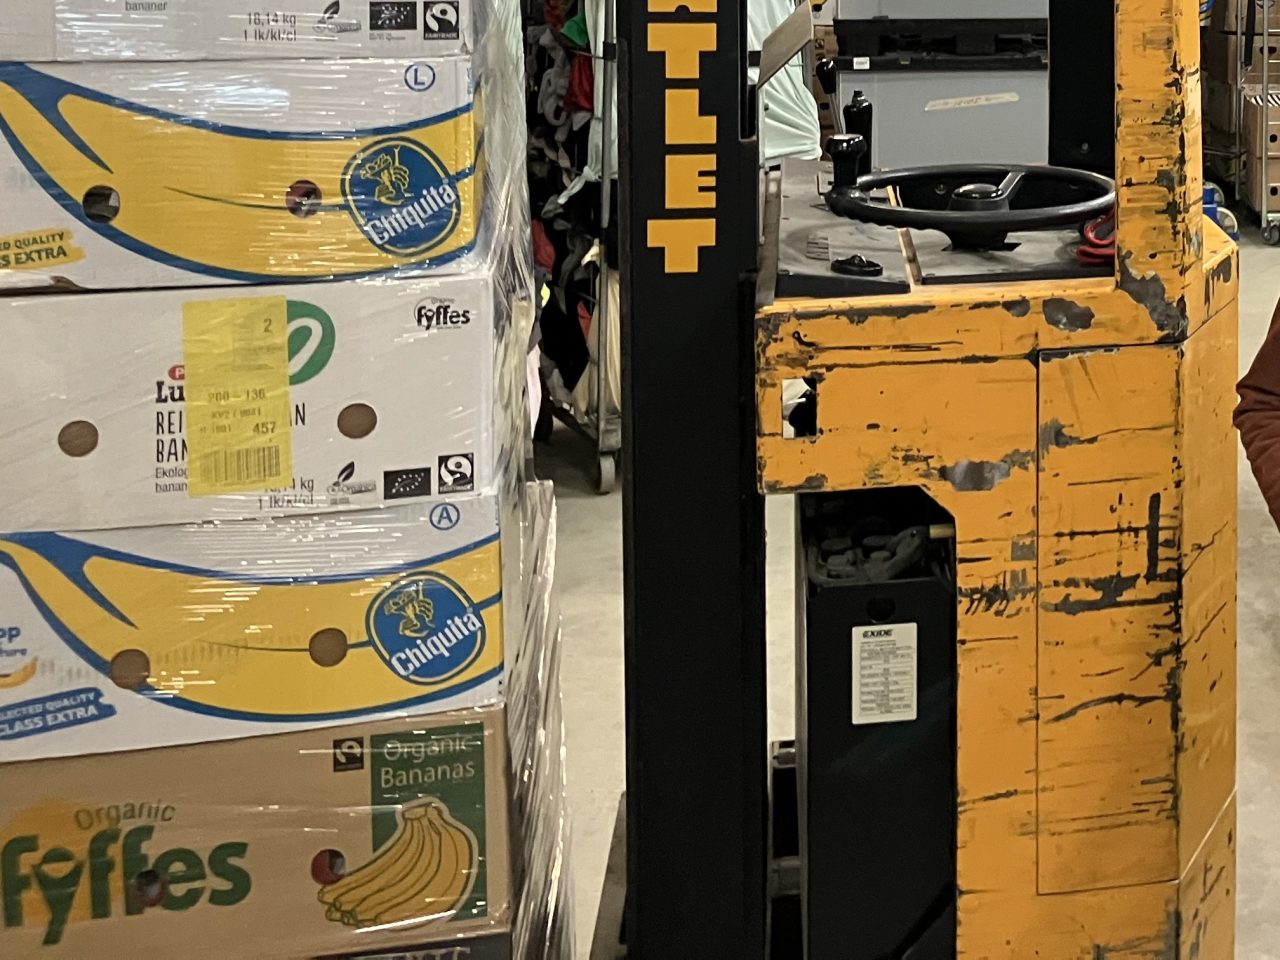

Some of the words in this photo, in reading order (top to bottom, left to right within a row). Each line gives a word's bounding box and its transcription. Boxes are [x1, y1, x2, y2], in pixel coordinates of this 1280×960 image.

[124, 0, 168, 12] bananer
[247, 11, 279, 27] 18,14
[282, 12, 297, 28] kg
[367, 183, 457, 245] Chiquita
[14, 231, 65, 250] QUALITY
[14, 244, 68, 265] EXTRA
[263, 317, 273, 333] 2
[300, 477, 315, 491] kg
[390, 612, 483, 676] Chiquita
[45, 704, 99, 727] EXTRA
[382, 732, 475, 763] Organic
[380, 759, 476, 789] Bananas
[73, 798, 177, 831] Organic
